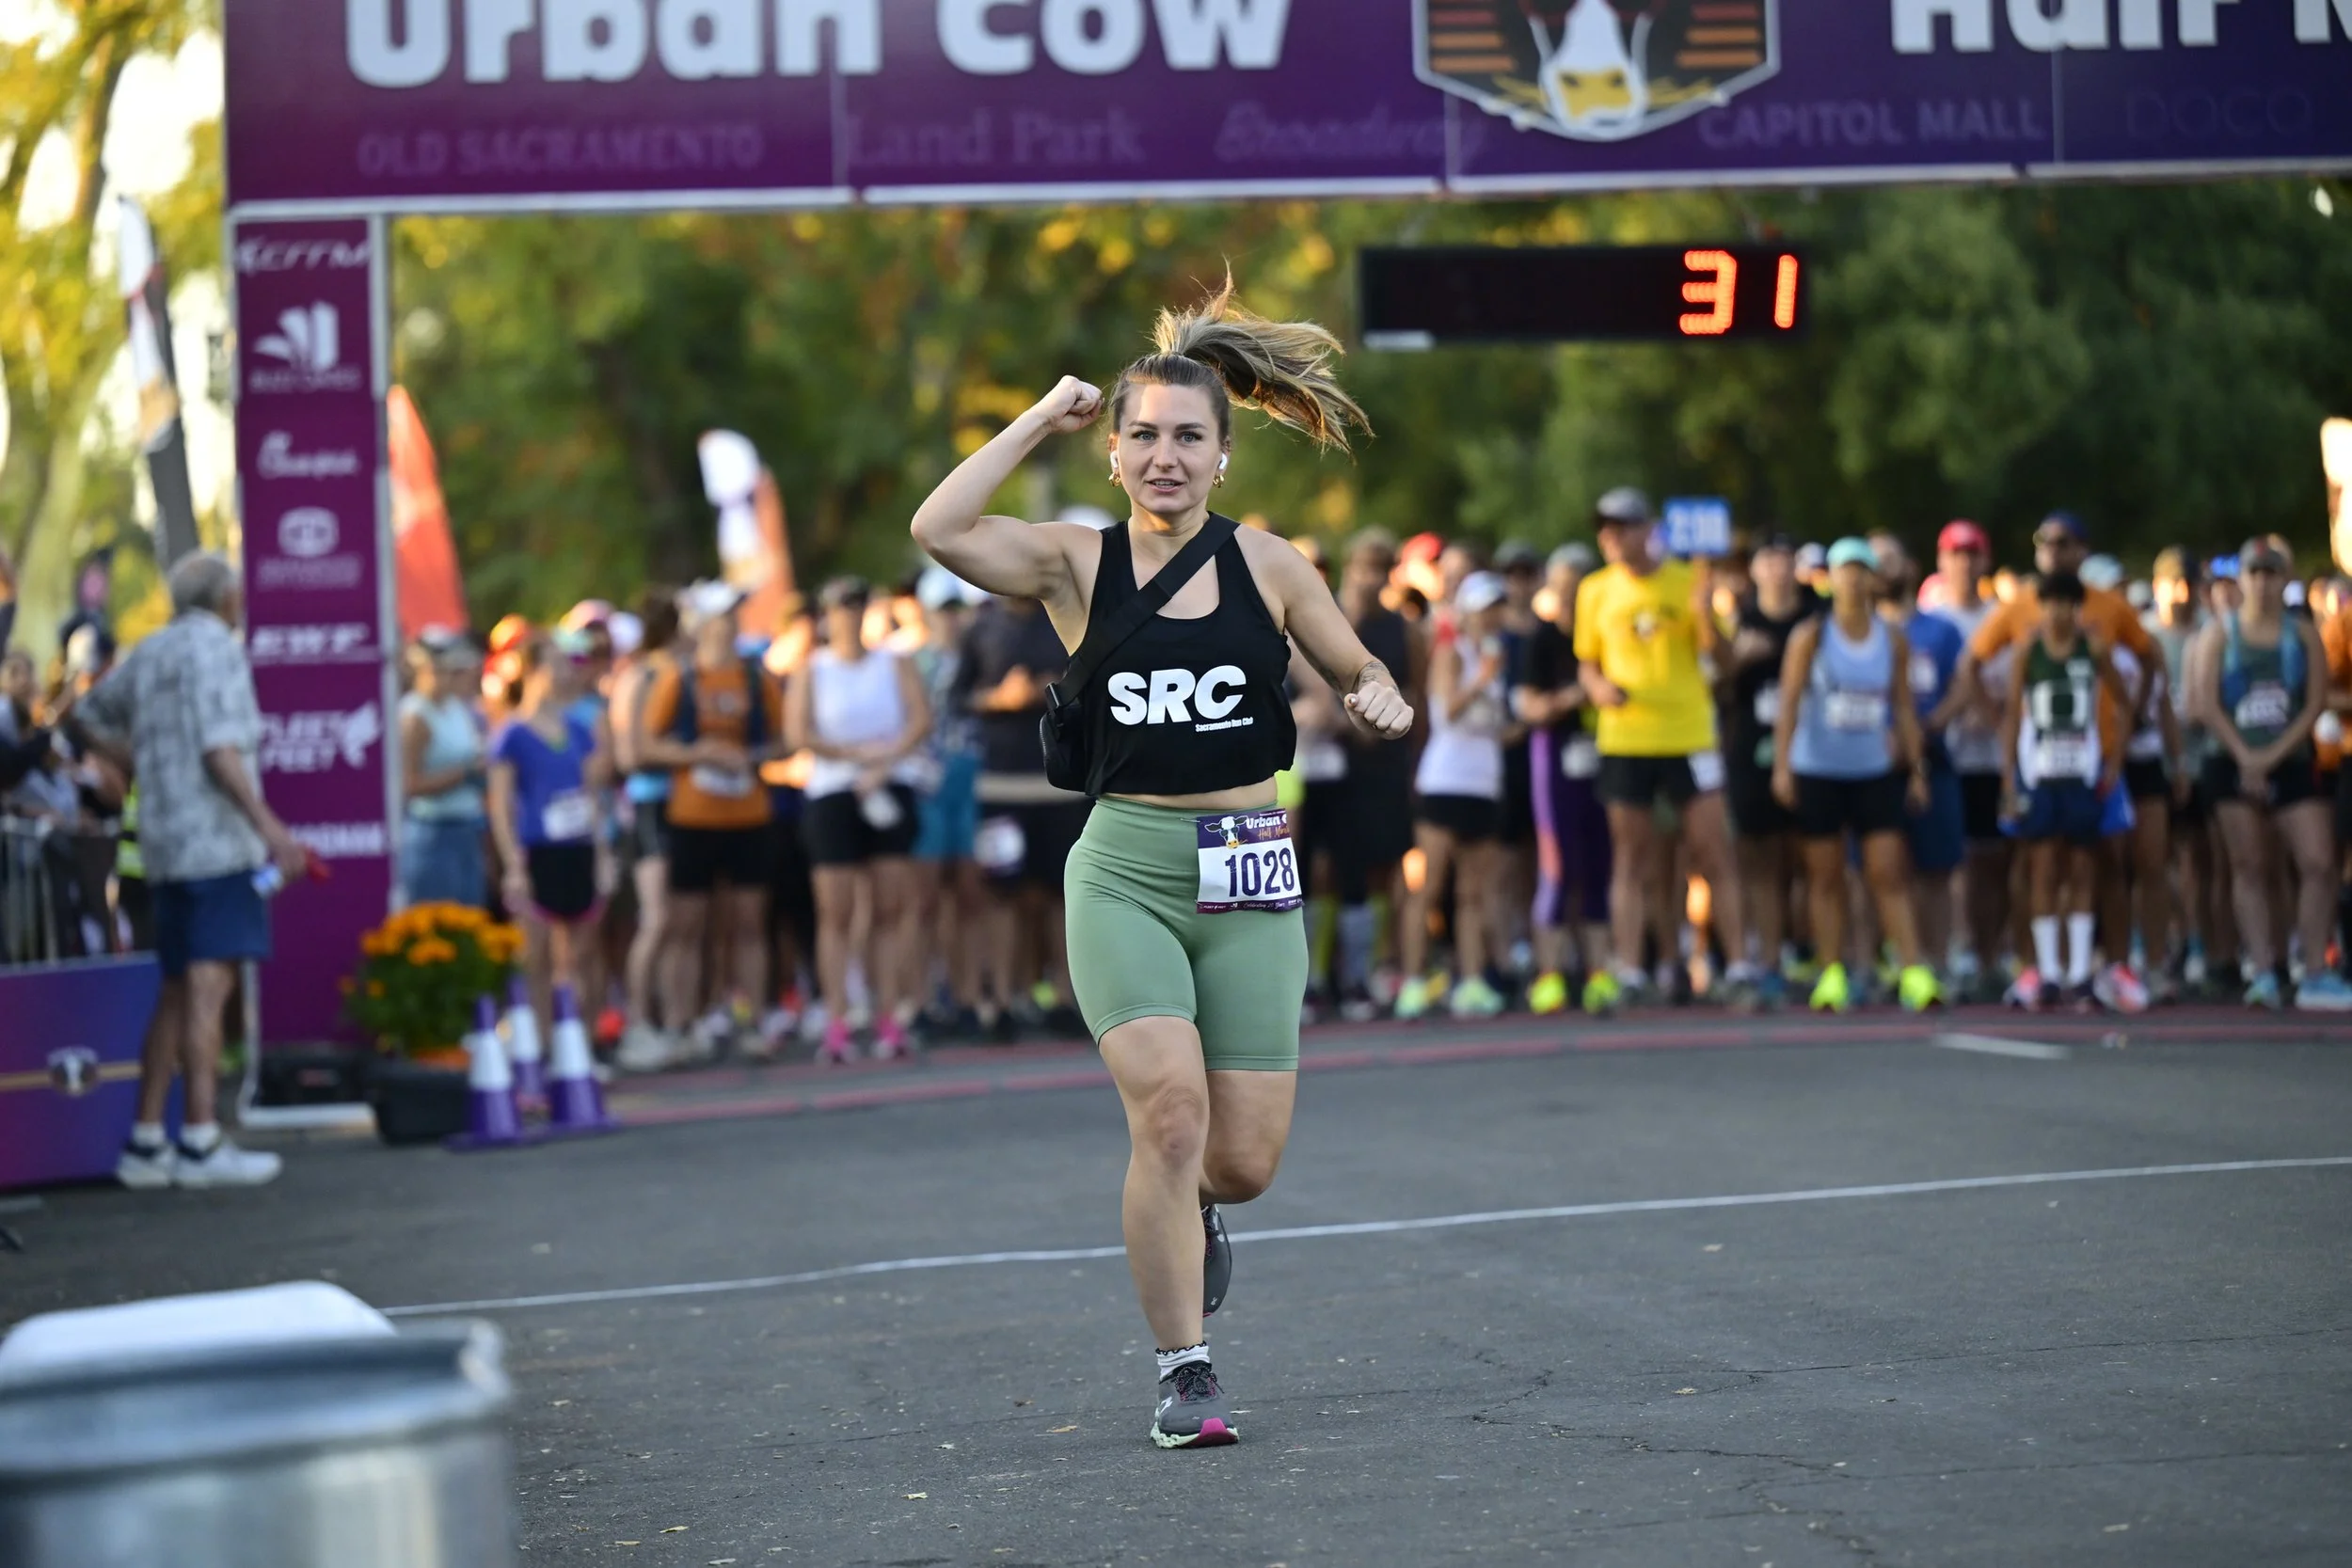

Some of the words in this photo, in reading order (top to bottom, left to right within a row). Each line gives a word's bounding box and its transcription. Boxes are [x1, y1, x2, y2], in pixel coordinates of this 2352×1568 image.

[345, 0, 882, 87] Urban
[937, 0, 1295, 75] Cow
[847, 107, 990, 167] Land
[1013, 105, 1146, 166] Park
[1214, 100, 1485, 163] Broadway
[1697, 98, 1907, 150] CAPITOL
[1916, 95, 2046, 143] MALL
[2125, 87, 2312, 139] DOCO
[357, 129, 447, 178] OLD
[457, 120, 766, 176] SACRAMENTO
[1107, 664, 1247, 726] SRC
[1246, 816, 1280, 829] Urban
[1225, 847, 1295, 897] 1028
